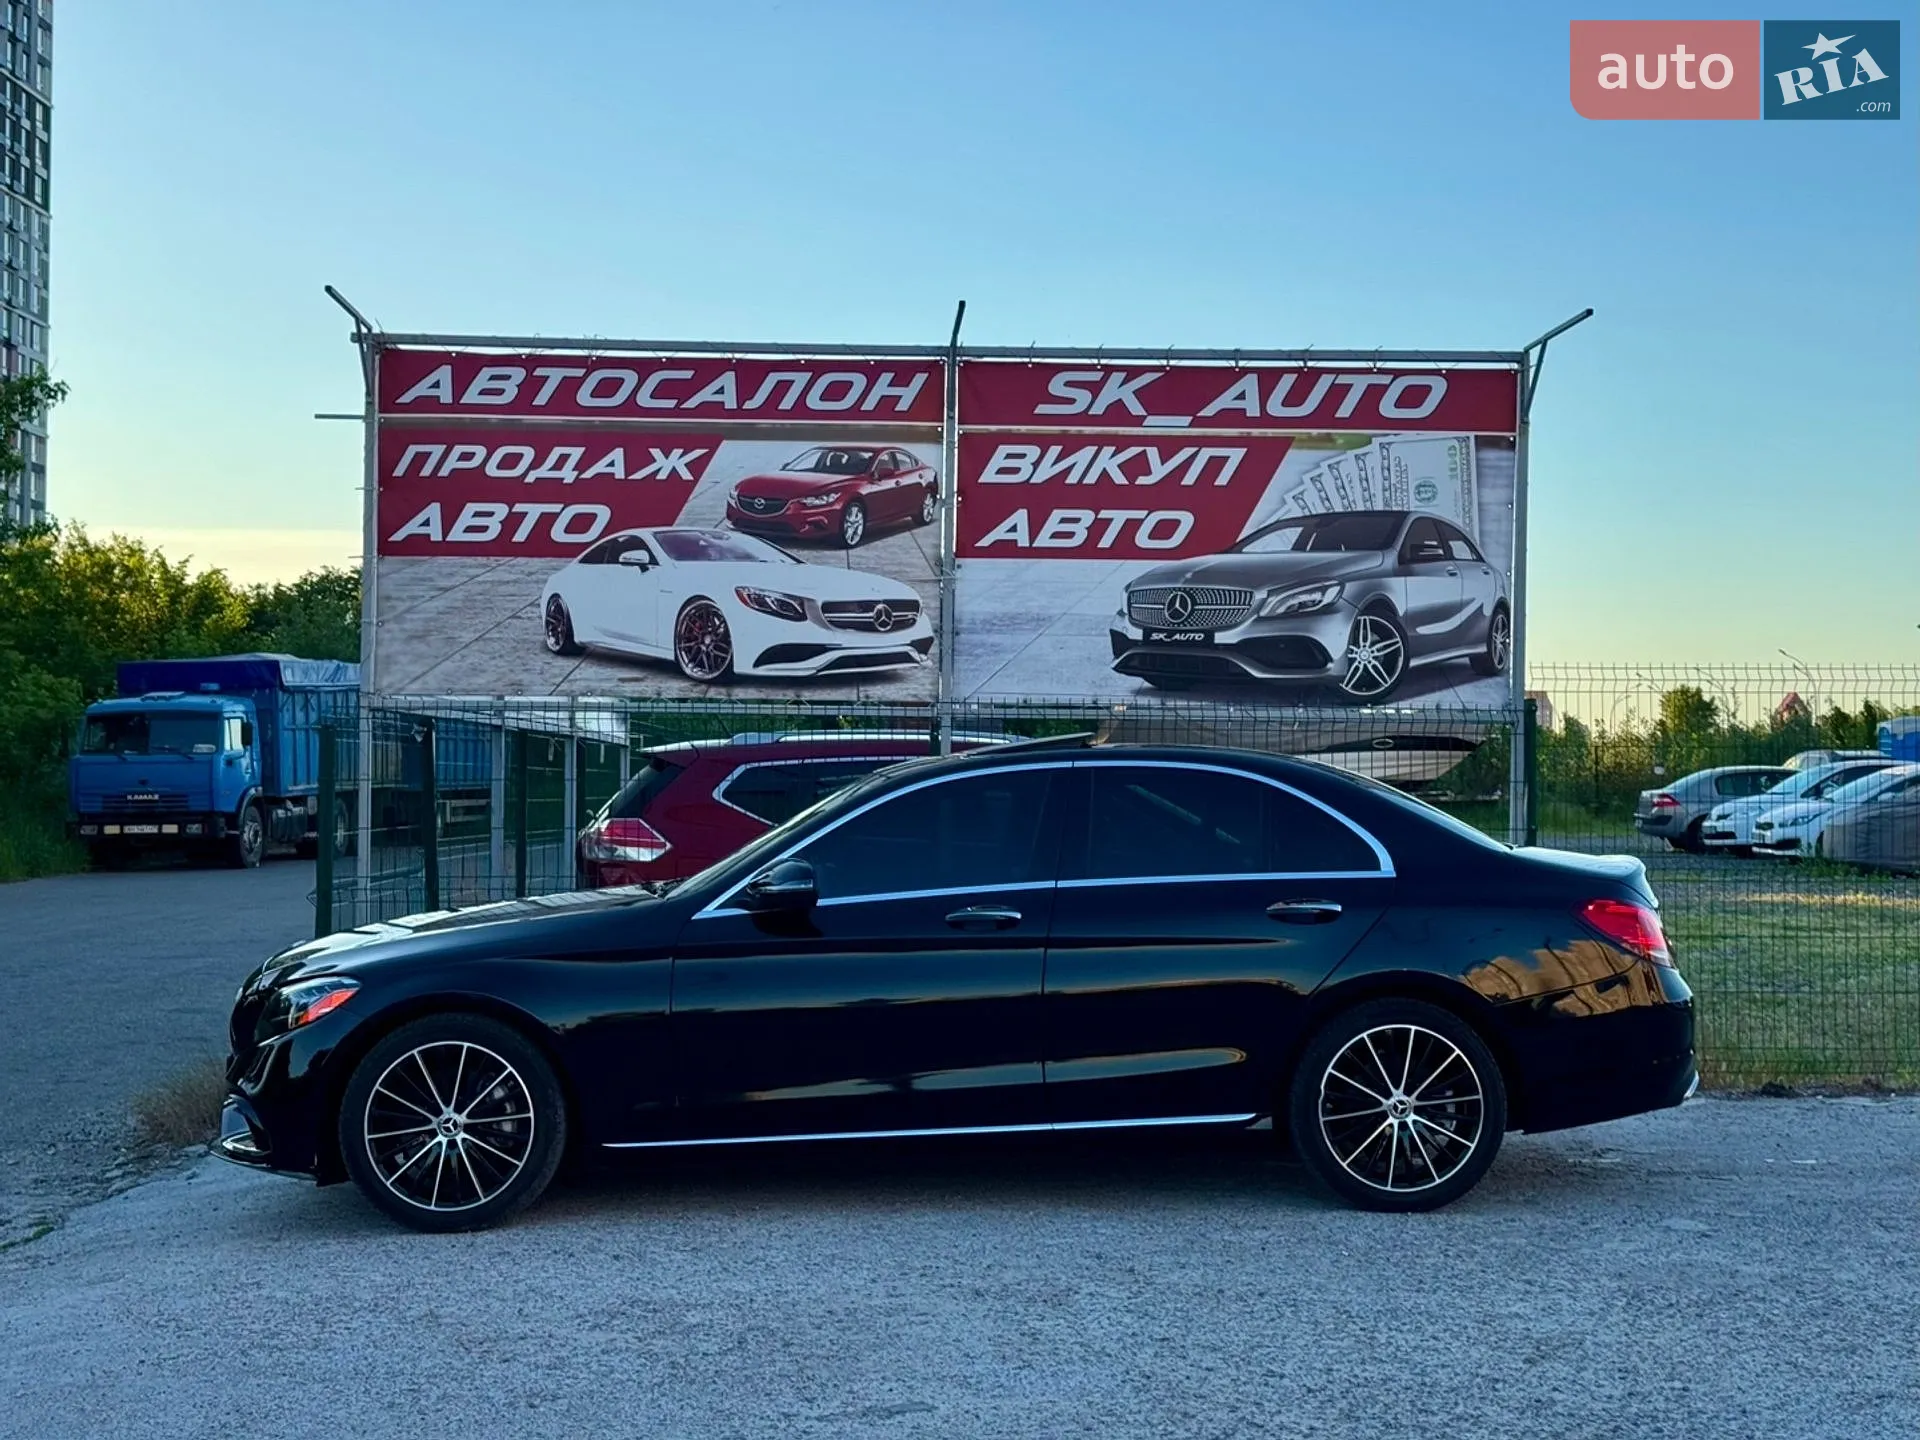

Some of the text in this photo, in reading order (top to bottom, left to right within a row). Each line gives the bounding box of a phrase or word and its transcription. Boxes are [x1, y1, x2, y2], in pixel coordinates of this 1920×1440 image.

[395, 364, 930, 412] АВТОСАЛОН
[1033, 370, 1450, 427] SK_AUTO
[392, 443, 710, 485] ПРОДАЖ
[977, 444, 1248, 487] ВИКУП
[388, 502, 613, 543] АВТО
[974, 508, 1195, 549] АВТО
[1149, 631, 1205, 643] SK_AUTO
